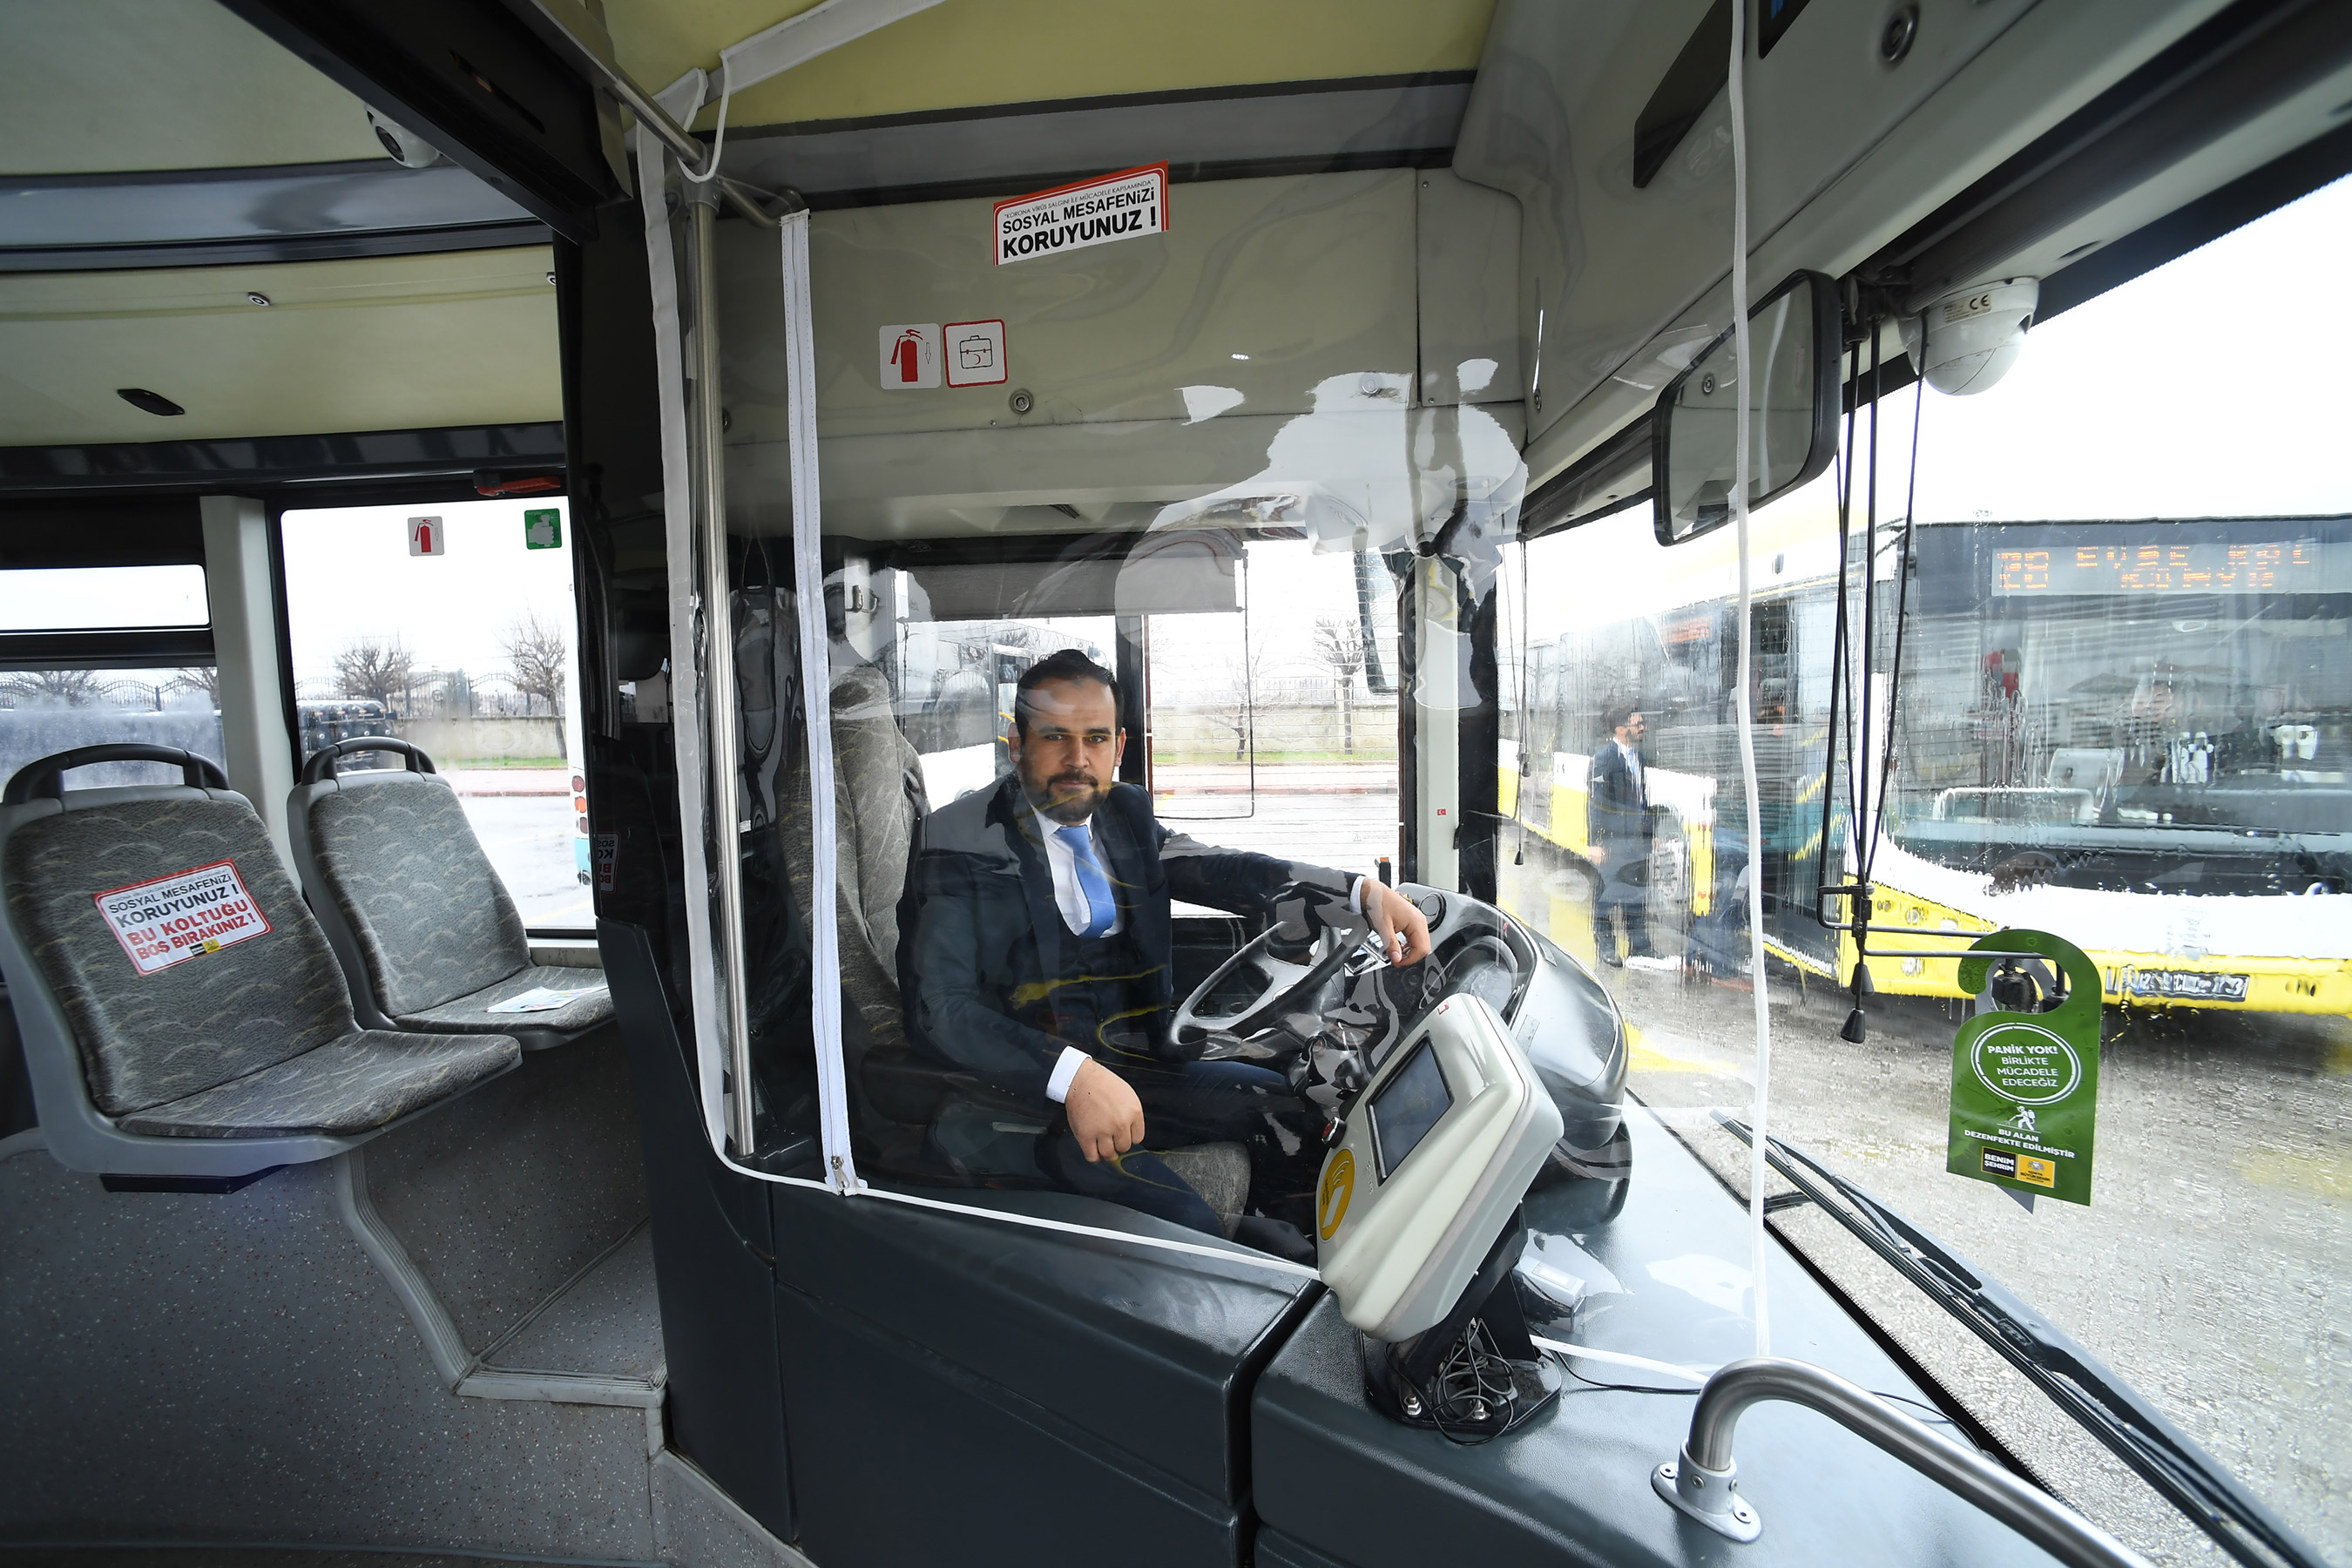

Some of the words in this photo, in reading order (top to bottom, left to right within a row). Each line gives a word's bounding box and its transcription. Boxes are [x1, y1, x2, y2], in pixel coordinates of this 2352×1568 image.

[1048, 199, 1070, 209] SALGINI
[1079, 189, 1112, 200] MÜCADELE
[1003, 209, 1059, 234] SOSYAL
[1003, 209, 1142, 259] KORUYUNUZ
[1970, 294, 1990, 310] CE
[108, 894, 160, 914] SOSYAL
[115, 887, 229, 929] KORUYUNUZ
[126, 927, 157, 946] BU
[159, 899, 248, 936] KOLTUĞU
[135, 941, 171, 960] BOŞ
[171, 916, 248, 949] BIRAKINIZ
[1987, 1044, 2025, 1054] PANİK
[2026, 1045, 2058, 1054] YOK!
[2001, 1055, 2049, 1065] BİRLİKTE
[1997, 1066, 2058, 1076] MÜCADELE
[2002, 1077, 2058, 1087] EDECEĞİZ
[1964, 1129, 2021, 1147] DEZENFEKTE
[2022, 1141, 2075, 1159] EDİLMİŞTİR
[1998, 1128, 2011, 1137] BU
[2012, 1132, 2039, 1143] ALAN
